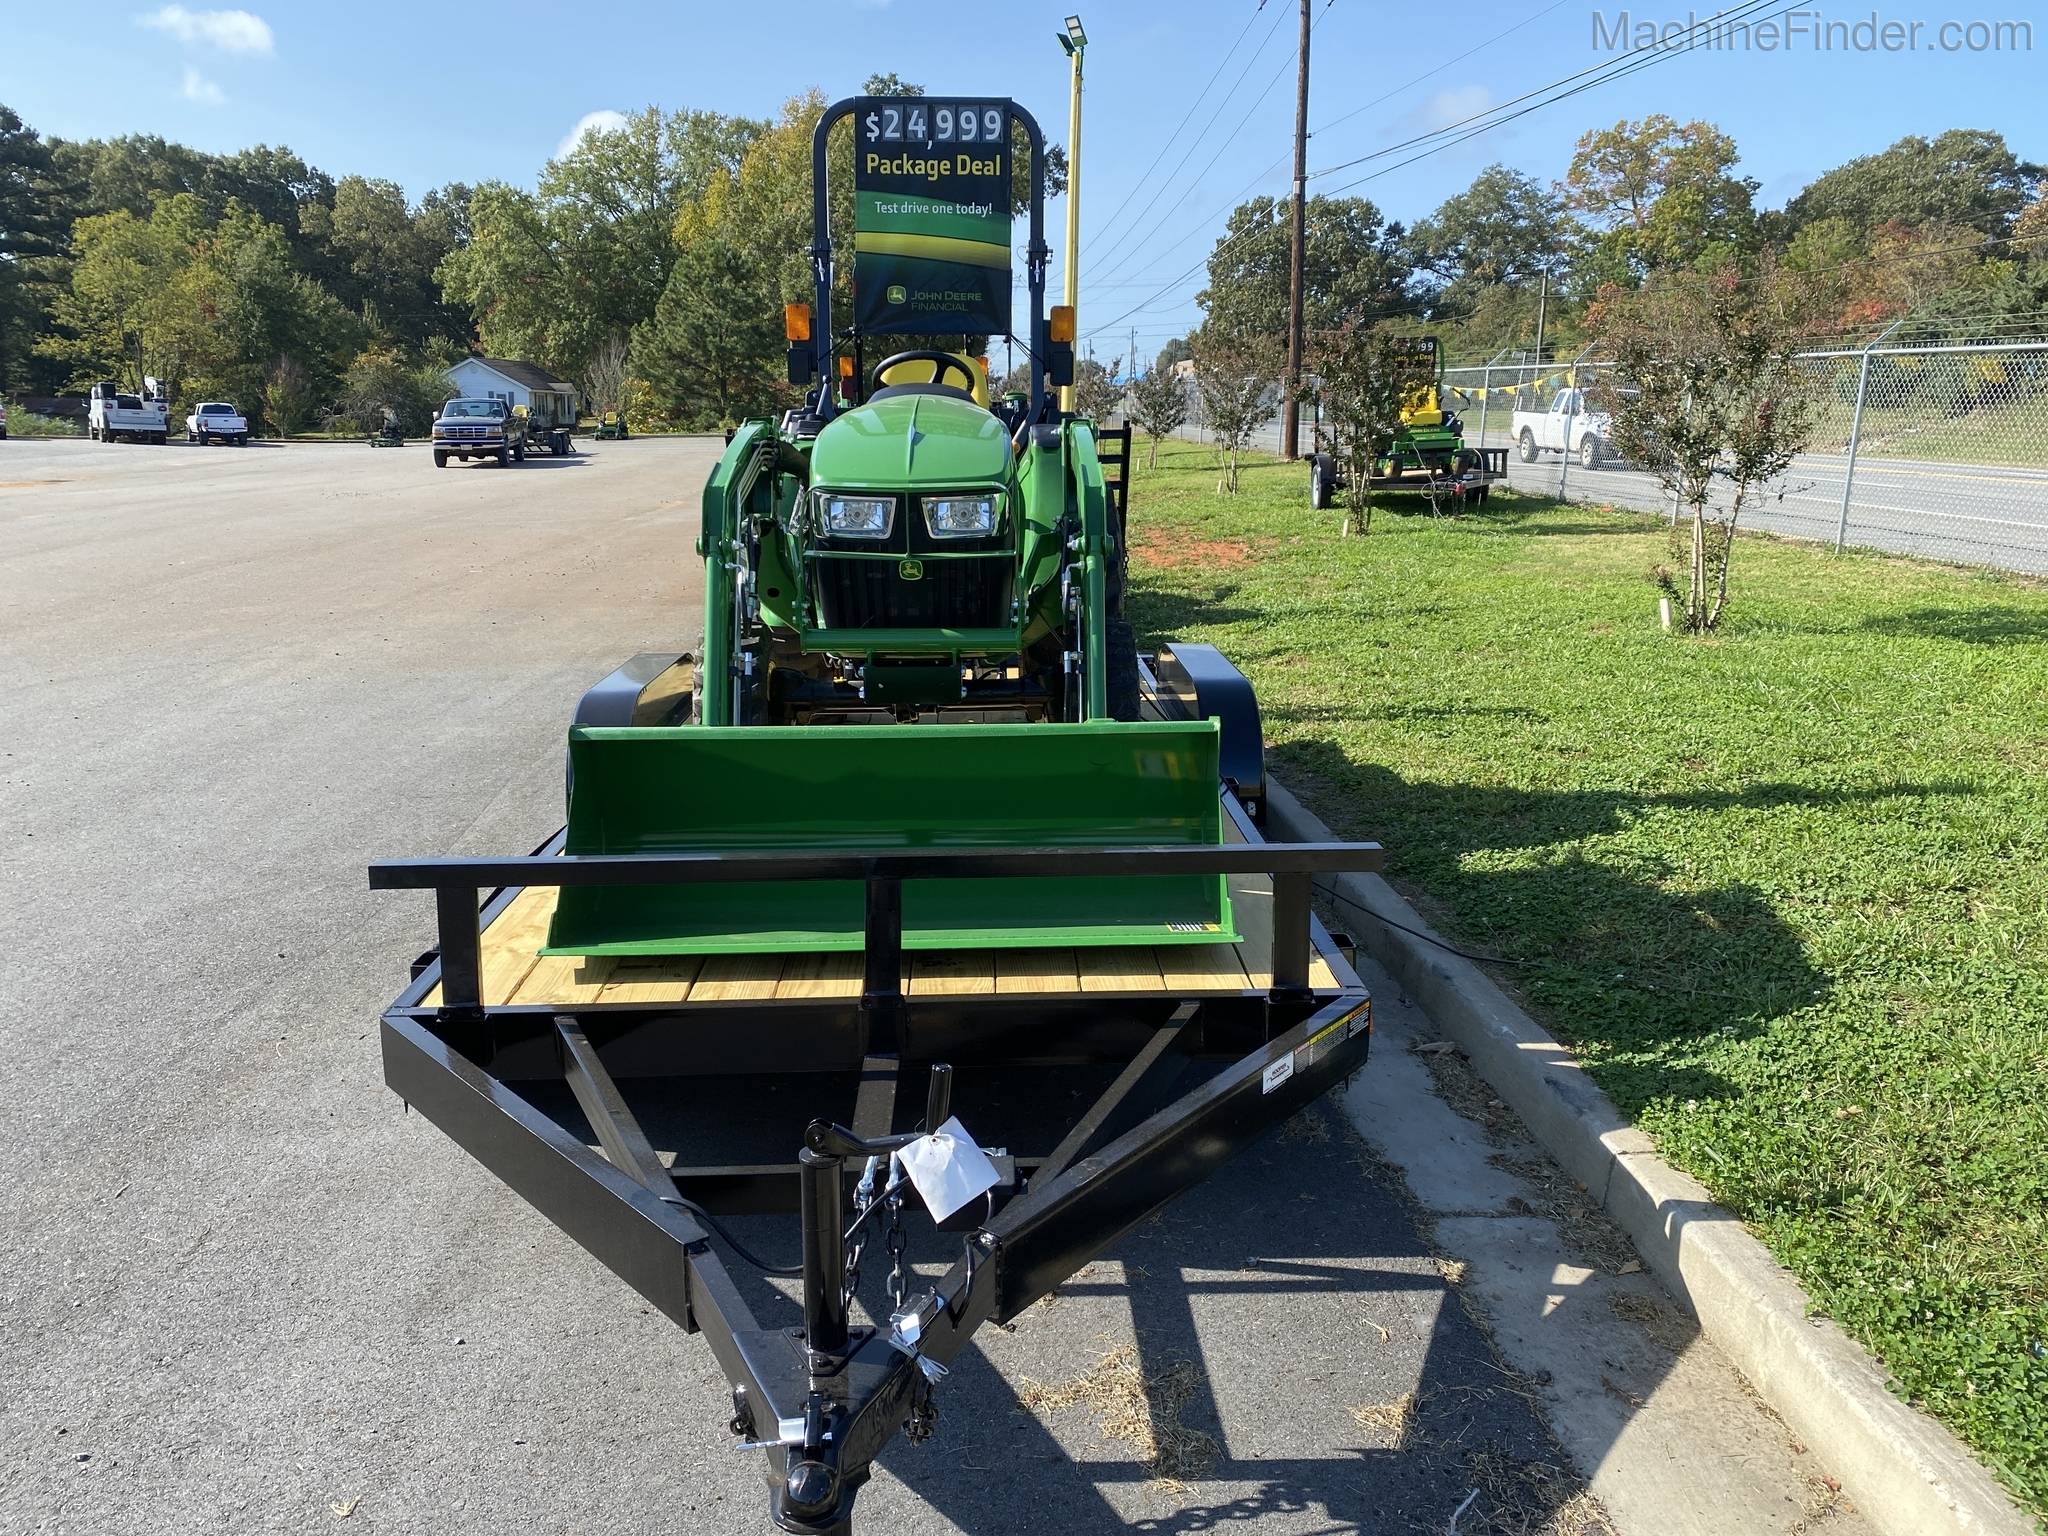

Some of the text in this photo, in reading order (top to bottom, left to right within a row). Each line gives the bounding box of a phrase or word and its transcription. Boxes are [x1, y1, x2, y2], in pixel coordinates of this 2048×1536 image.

[866, 109, 1001, 150] $24,999
[867, 154, 1001, 181] Package Deal
[875, 201, 992, 217] Test drive one today!
[911, 290, 982, 301] JOHN DEERE
[911, 302, 969, 312] FINANCIAL
